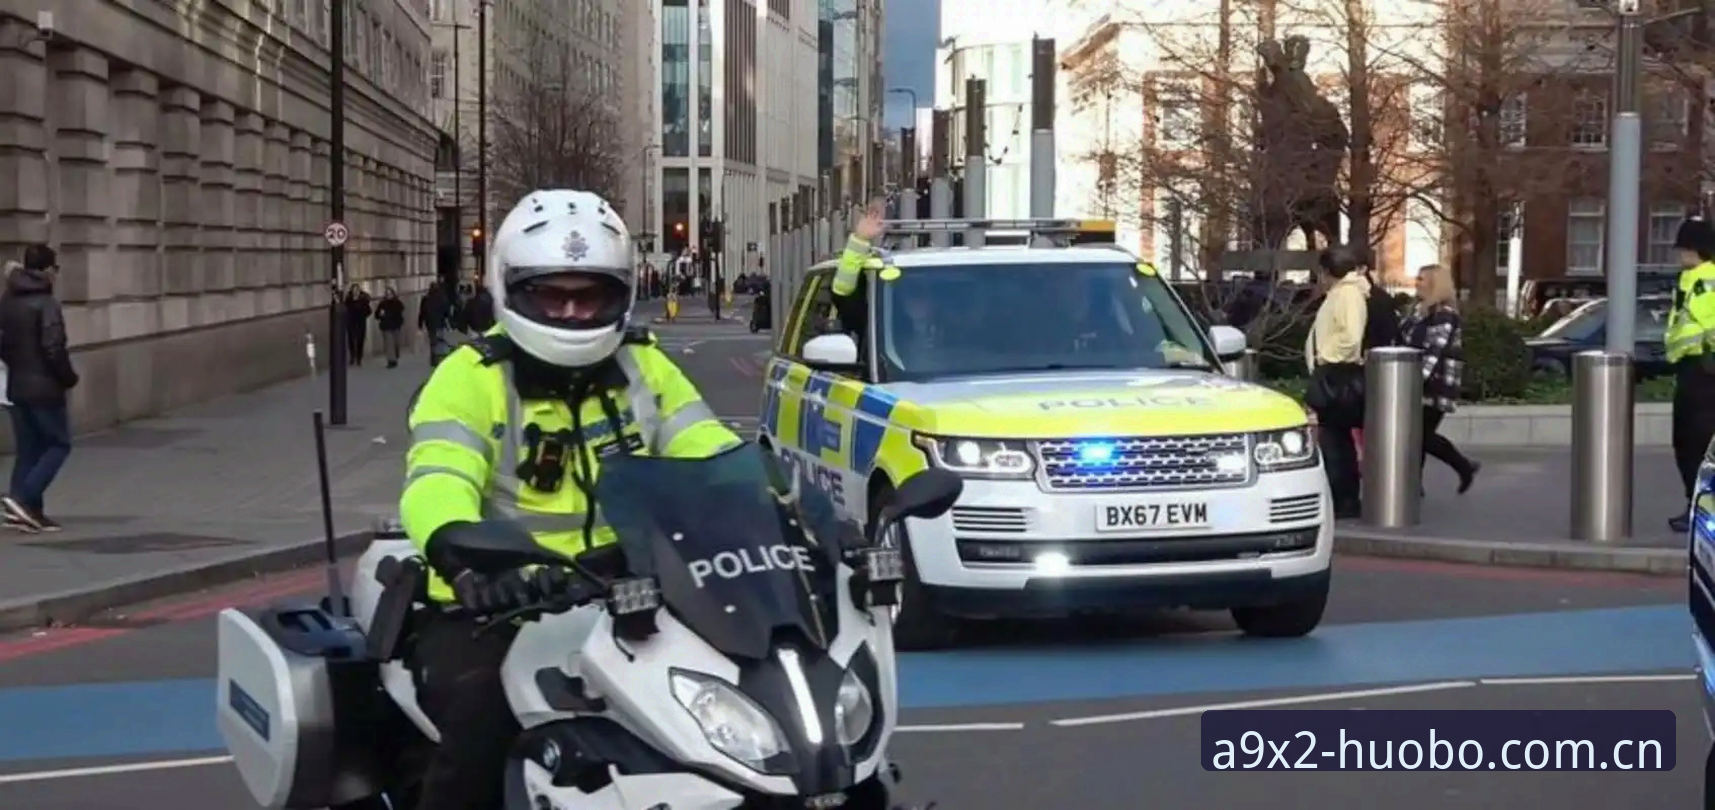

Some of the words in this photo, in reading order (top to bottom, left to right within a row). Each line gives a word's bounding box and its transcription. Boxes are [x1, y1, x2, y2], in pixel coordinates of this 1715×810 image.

[328, 228, 346, 240] 20
[1038, 396, 1216, 411] POLICE
[1106, 504, 1161, 526] BX67
[1166, 502, 1207, 524] EVM
[688, 544, 816, 588] POLICE
